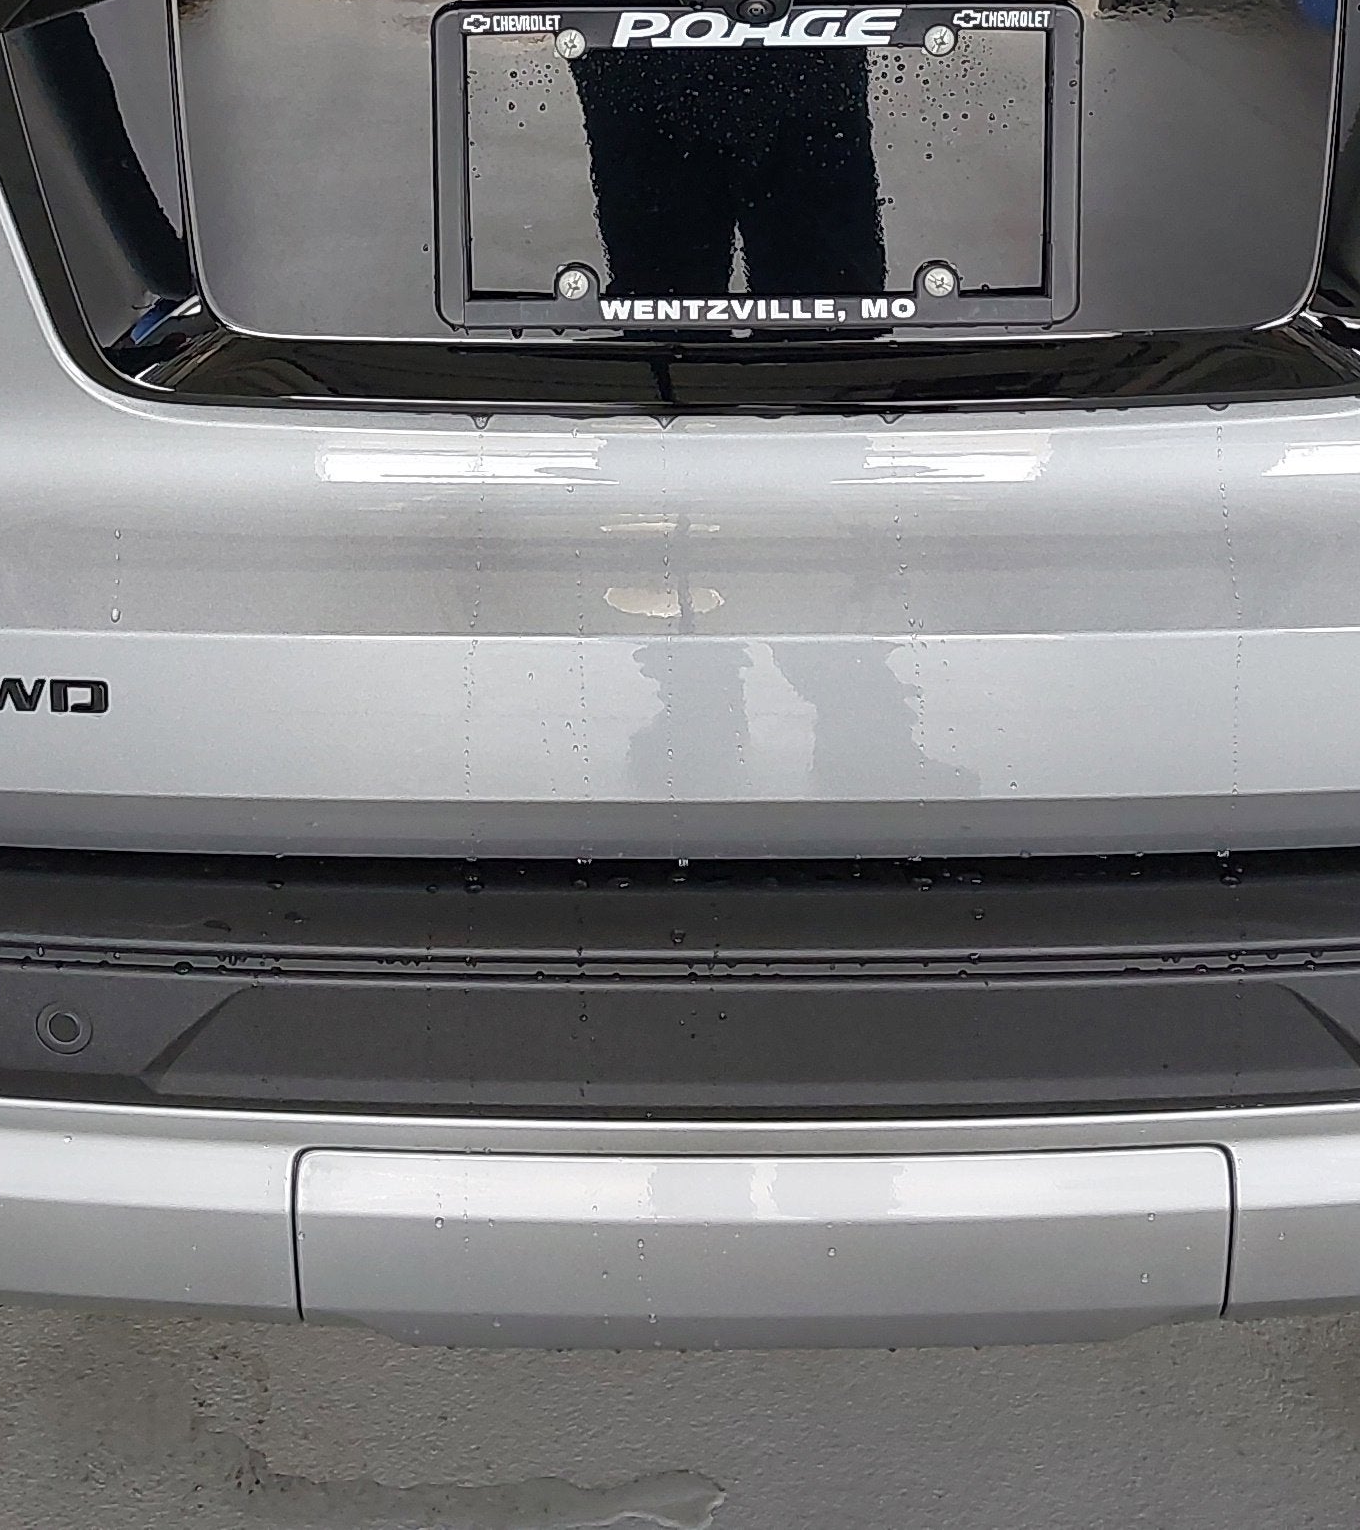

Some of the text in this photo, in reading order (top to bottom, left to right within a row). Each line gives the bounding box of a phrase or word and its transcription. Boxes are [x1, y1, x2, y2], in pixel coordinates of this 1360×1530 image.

[492, 14, 561, 32] CHEVROLET
[612, 8, 903, 48] POAGE
[981, 10, 1051, 28] CHEVROLET
[600, 298, 916, 322] WENTZVILLE, MO
